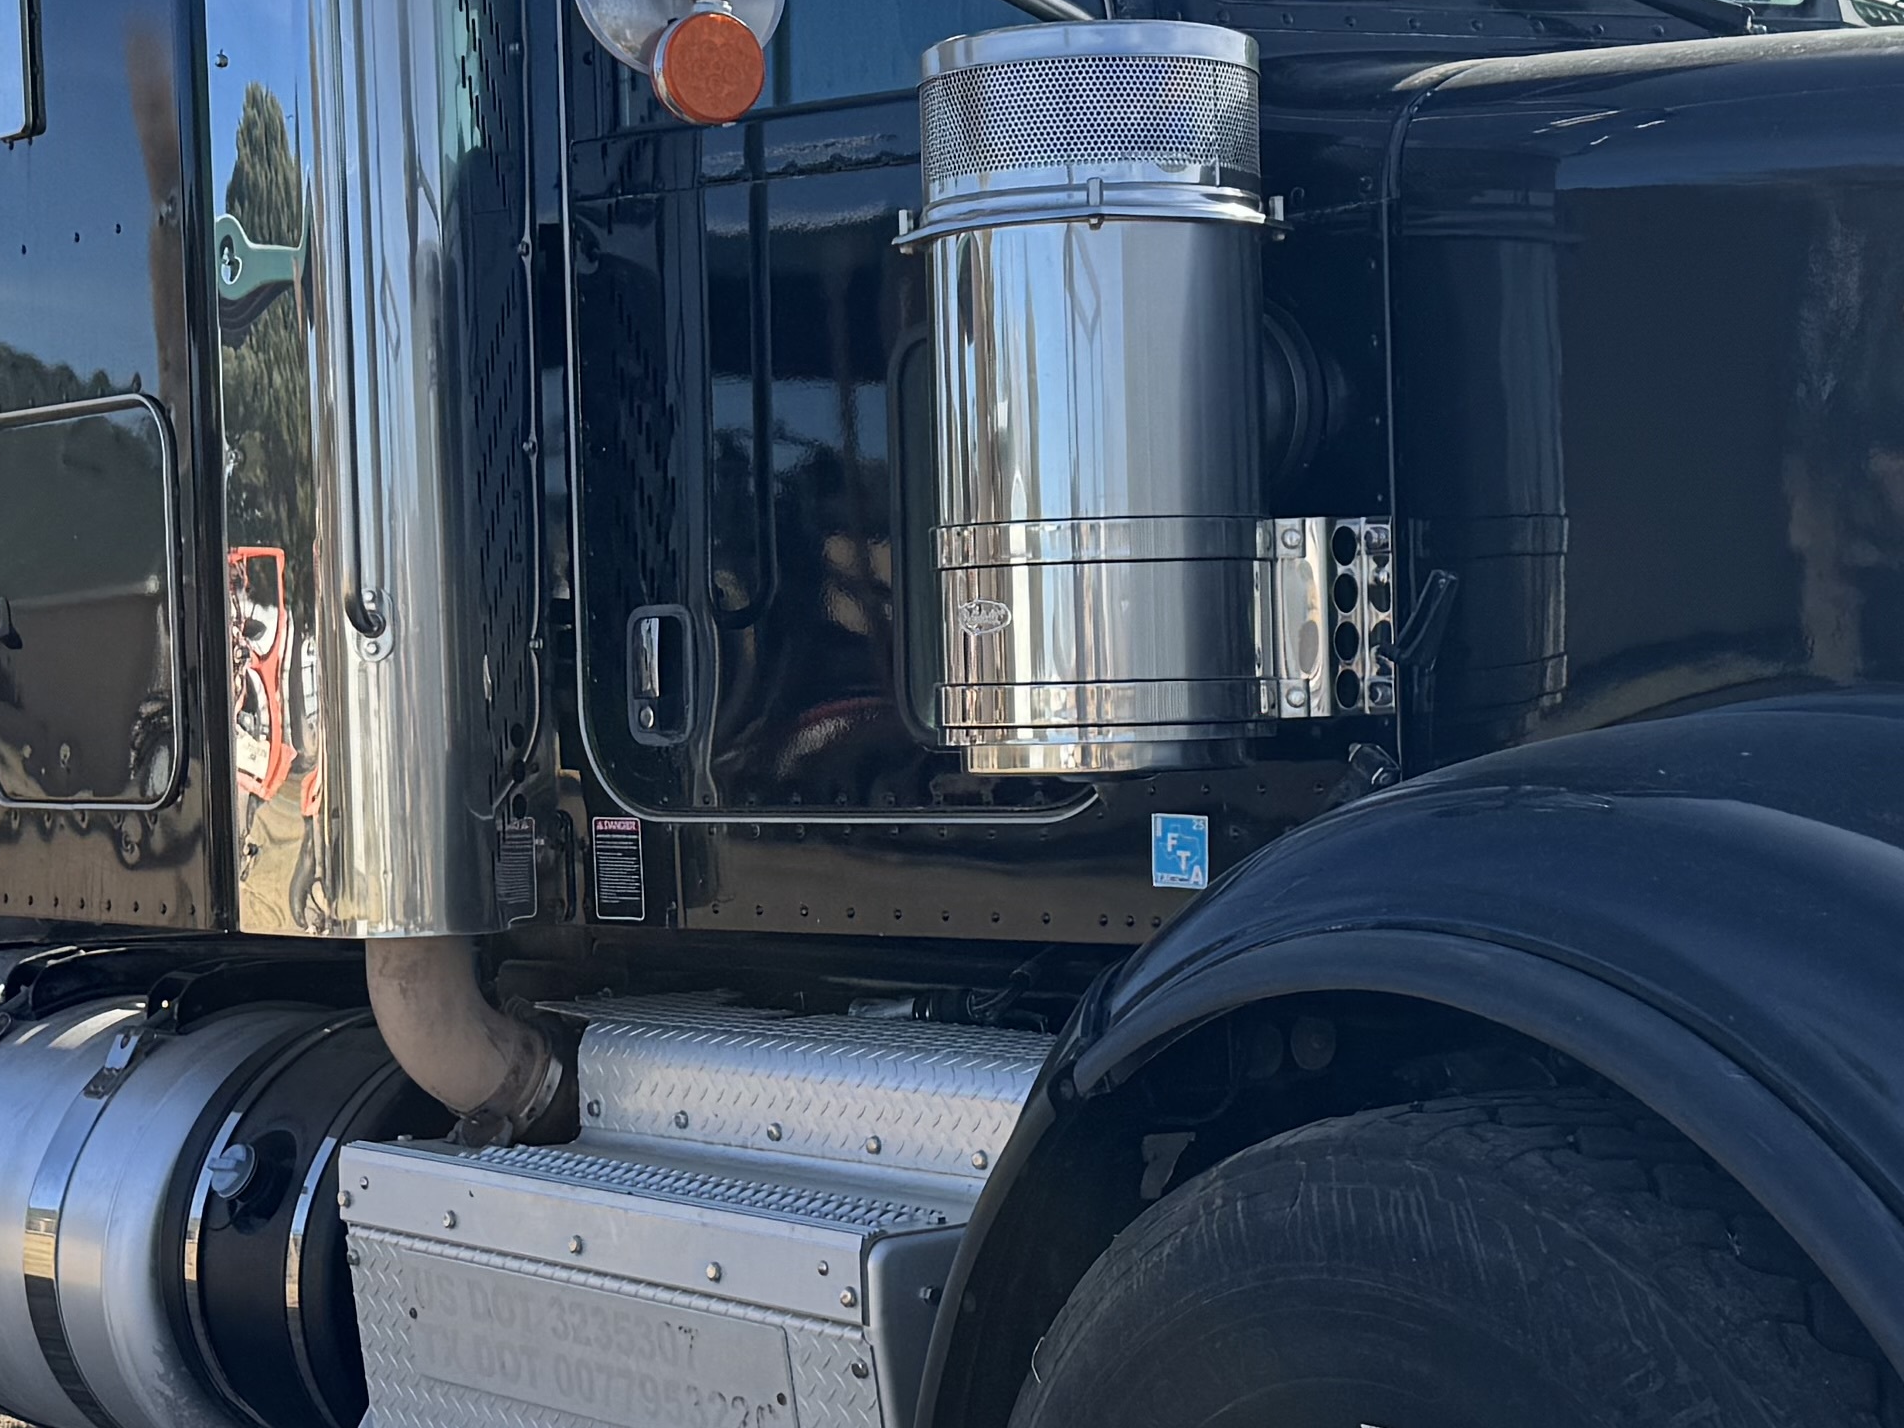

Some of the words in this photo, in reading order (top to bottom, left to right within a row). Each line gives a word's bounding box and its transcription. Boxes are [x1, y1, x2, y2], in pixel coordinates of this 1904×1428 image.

[1192, 819, 1205, 831] 25
[468, 1278, 541, 1338] DOT
[473, 1335, 539, 1390] DOT
